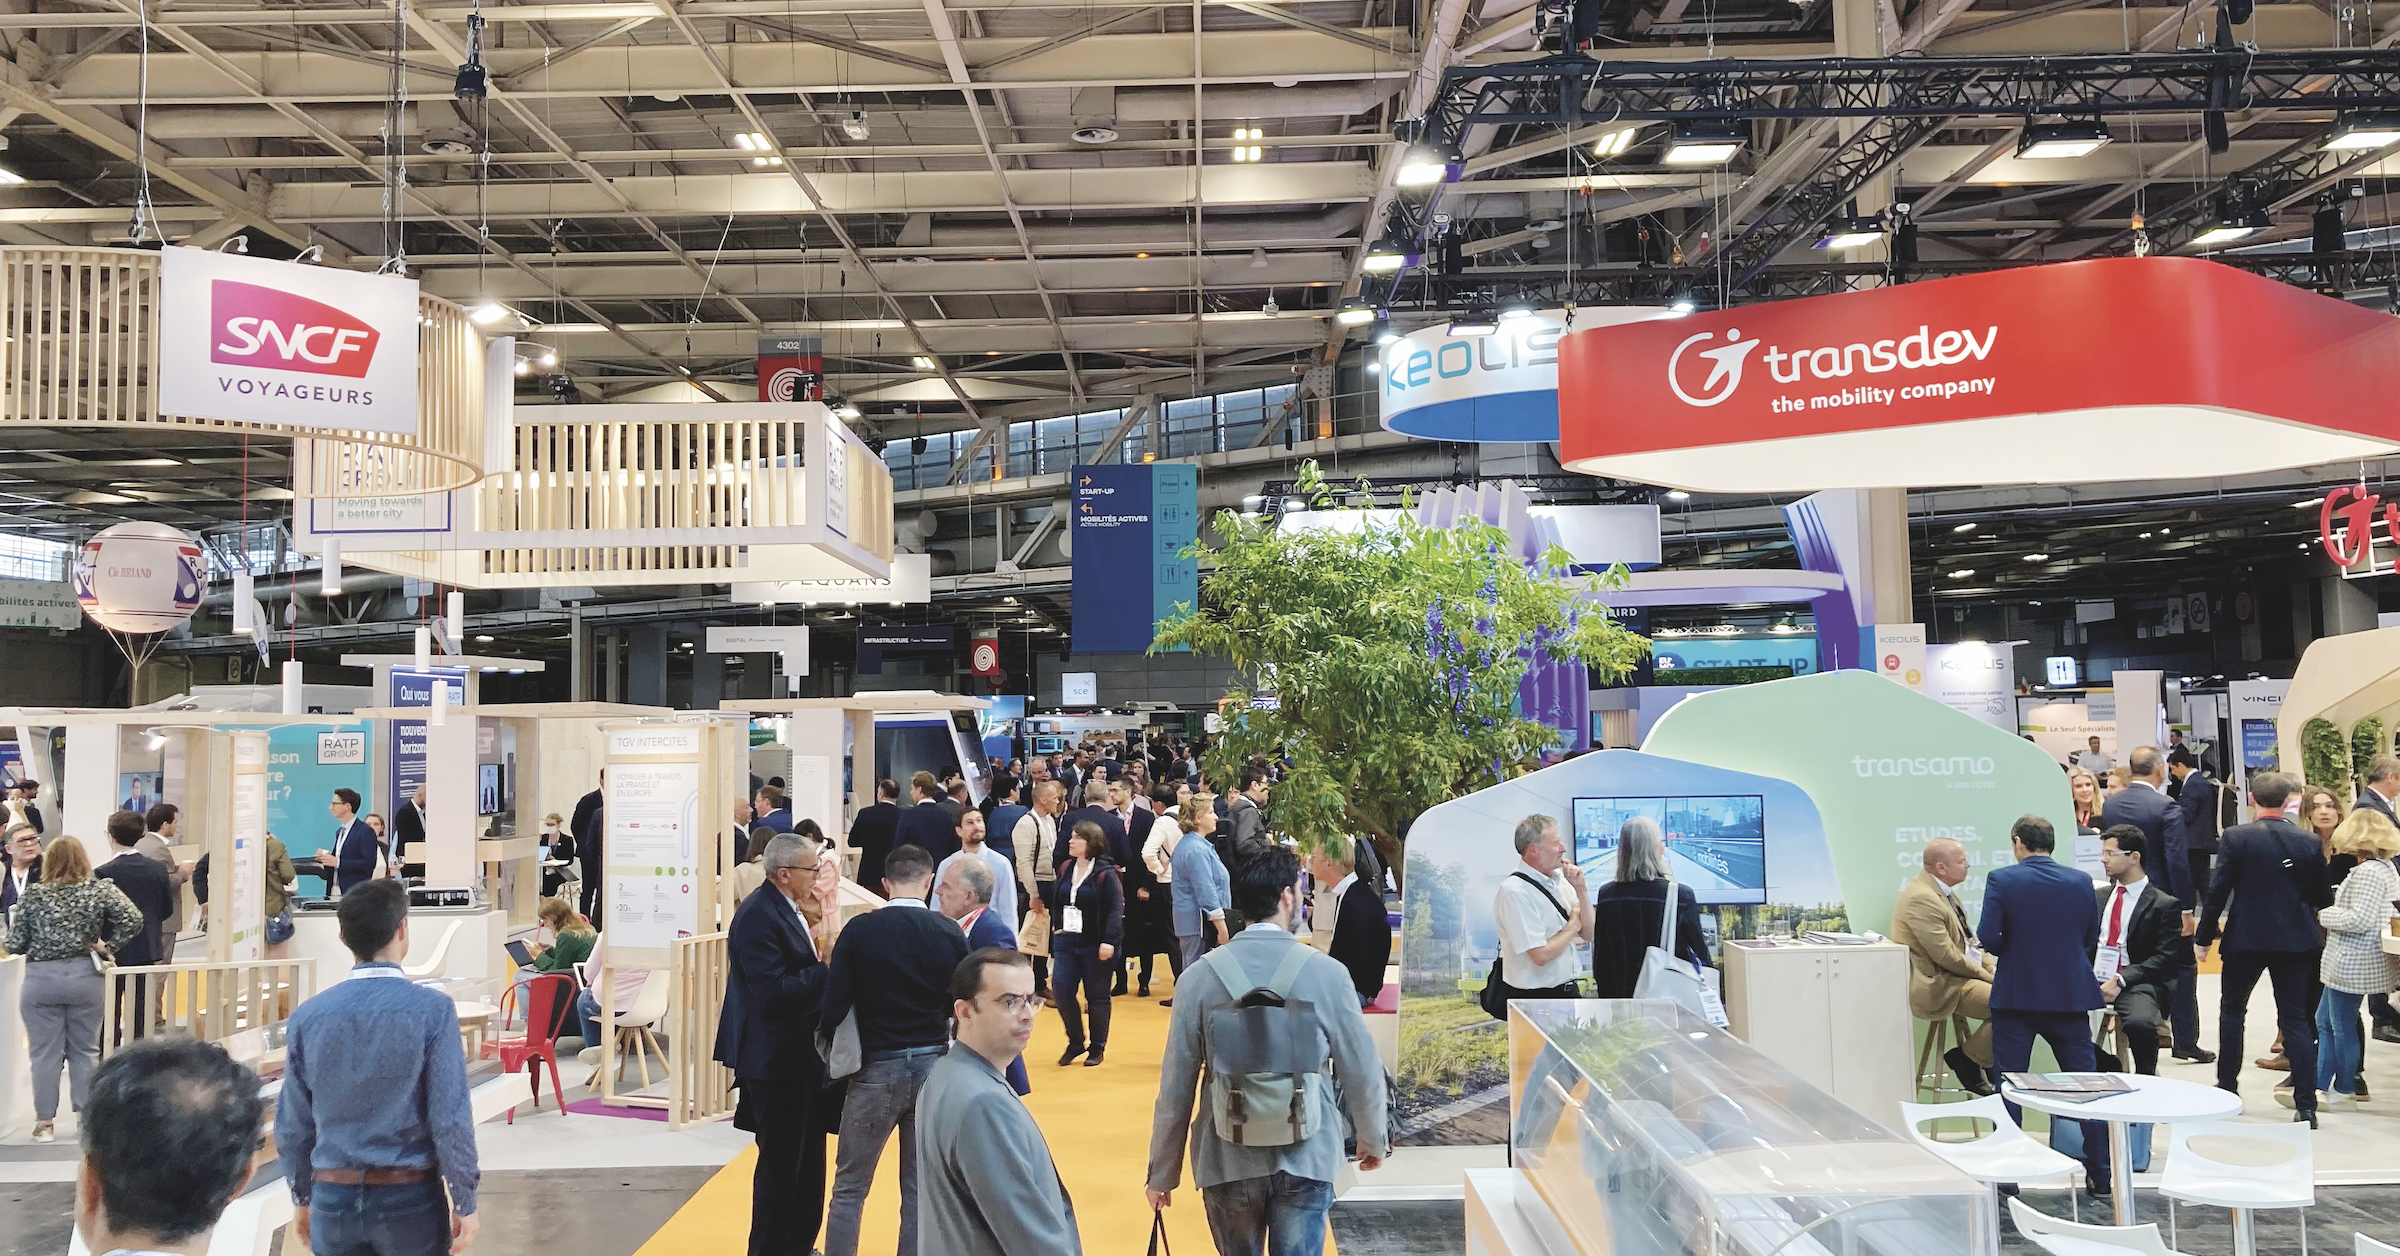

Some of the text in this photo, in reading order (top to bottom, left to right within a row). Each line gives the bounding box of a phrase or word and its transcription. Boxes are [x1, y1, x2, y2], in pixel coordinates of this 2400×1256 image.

[218, 316, 369, 364] SNCF
[776, 341, 800, 350] 4302
[1763, 325, 1998, 383] transdev
[218, 376, 374, 406] VOYAGEURS
[1771, 377, 1996, 414] the mobility company
[338, 495, 423, 507] Moving towards
[347, 508, 380, 517] better
[383, 508, 403, 519] city
[1080, 514, 1118, 522] MOBILITÉS
[108, 566, 152, 579] Cie BRIAND
[36, 599, 77, 608] actives
[401, 685, 430, 701] Qui vous
[2077, 725, 2116, 733] Spécialiste
[324, 738, 359, 749] RATP
[617, 734, 688, 748] TGV INTERCITÉS
[324, 750, 359, 758] GROUP
[1852, 754, 1996, 778] transamo
[616, 773, 647, 781] VOYAGER
[655, 772, 682, 780] TRAVERS
[616, 780, 661, 789] LA FRANCE ET
[616, 789, 653, 797] EN EUROPE
[1895, 825, 1983, 844] ETUDES,
[618, 882, 624, 892] 2
[653, 883, 659, 892] 4
